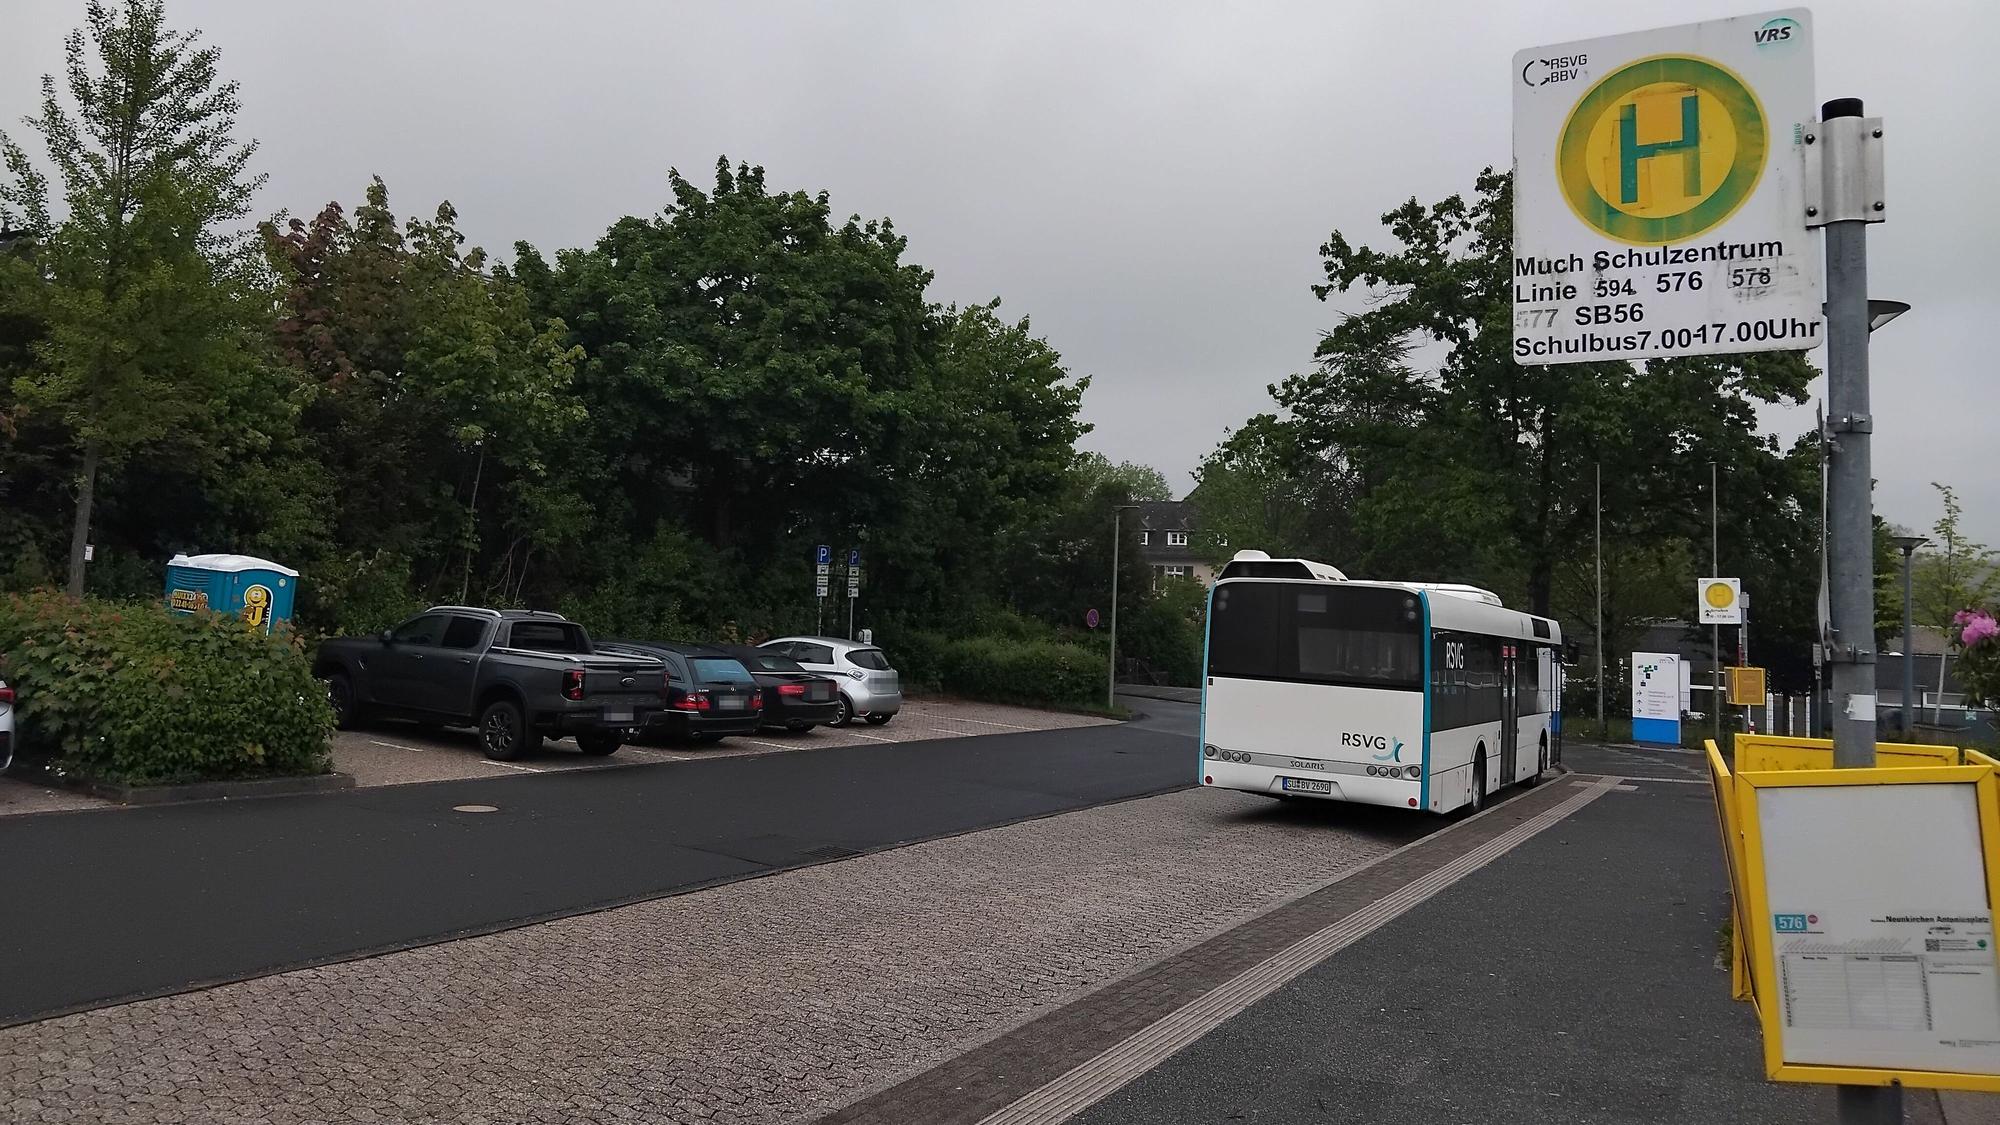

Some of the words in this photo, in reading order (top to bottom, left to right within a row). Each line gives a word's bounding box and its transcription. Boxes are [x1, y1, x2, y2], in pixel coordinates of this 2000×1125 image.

[1754, 26, 1792, 43] VRS
[1550, 54, 1587, 70] RSVG
[1550, 69, 1578, 83] BBV
[1620, 95, 1701, 204] H
[1515, 253, 1584, 277] Much
[1593, 240, 1783, 272] Schulzentrum
[1515, 281, 1577, 303] Linie
[1595, 278, 1634, 298] 594
[1656, 271, 1703, 293] 576
[1574, 303, 1644, 326] SB56
[820, 547, 828, 562] P
[851, 550, 858, 564] P
[1446, 642, 1464, 669] RSVG
[1341, 732, 1387, 750] RSVG
[1290, 760, 1325, 770] SOLARIS
[1301, 781, 1310, 790] BV
[1311, 782, 1329, 792] 2690
[1779, 916, 1803, 929] 576
